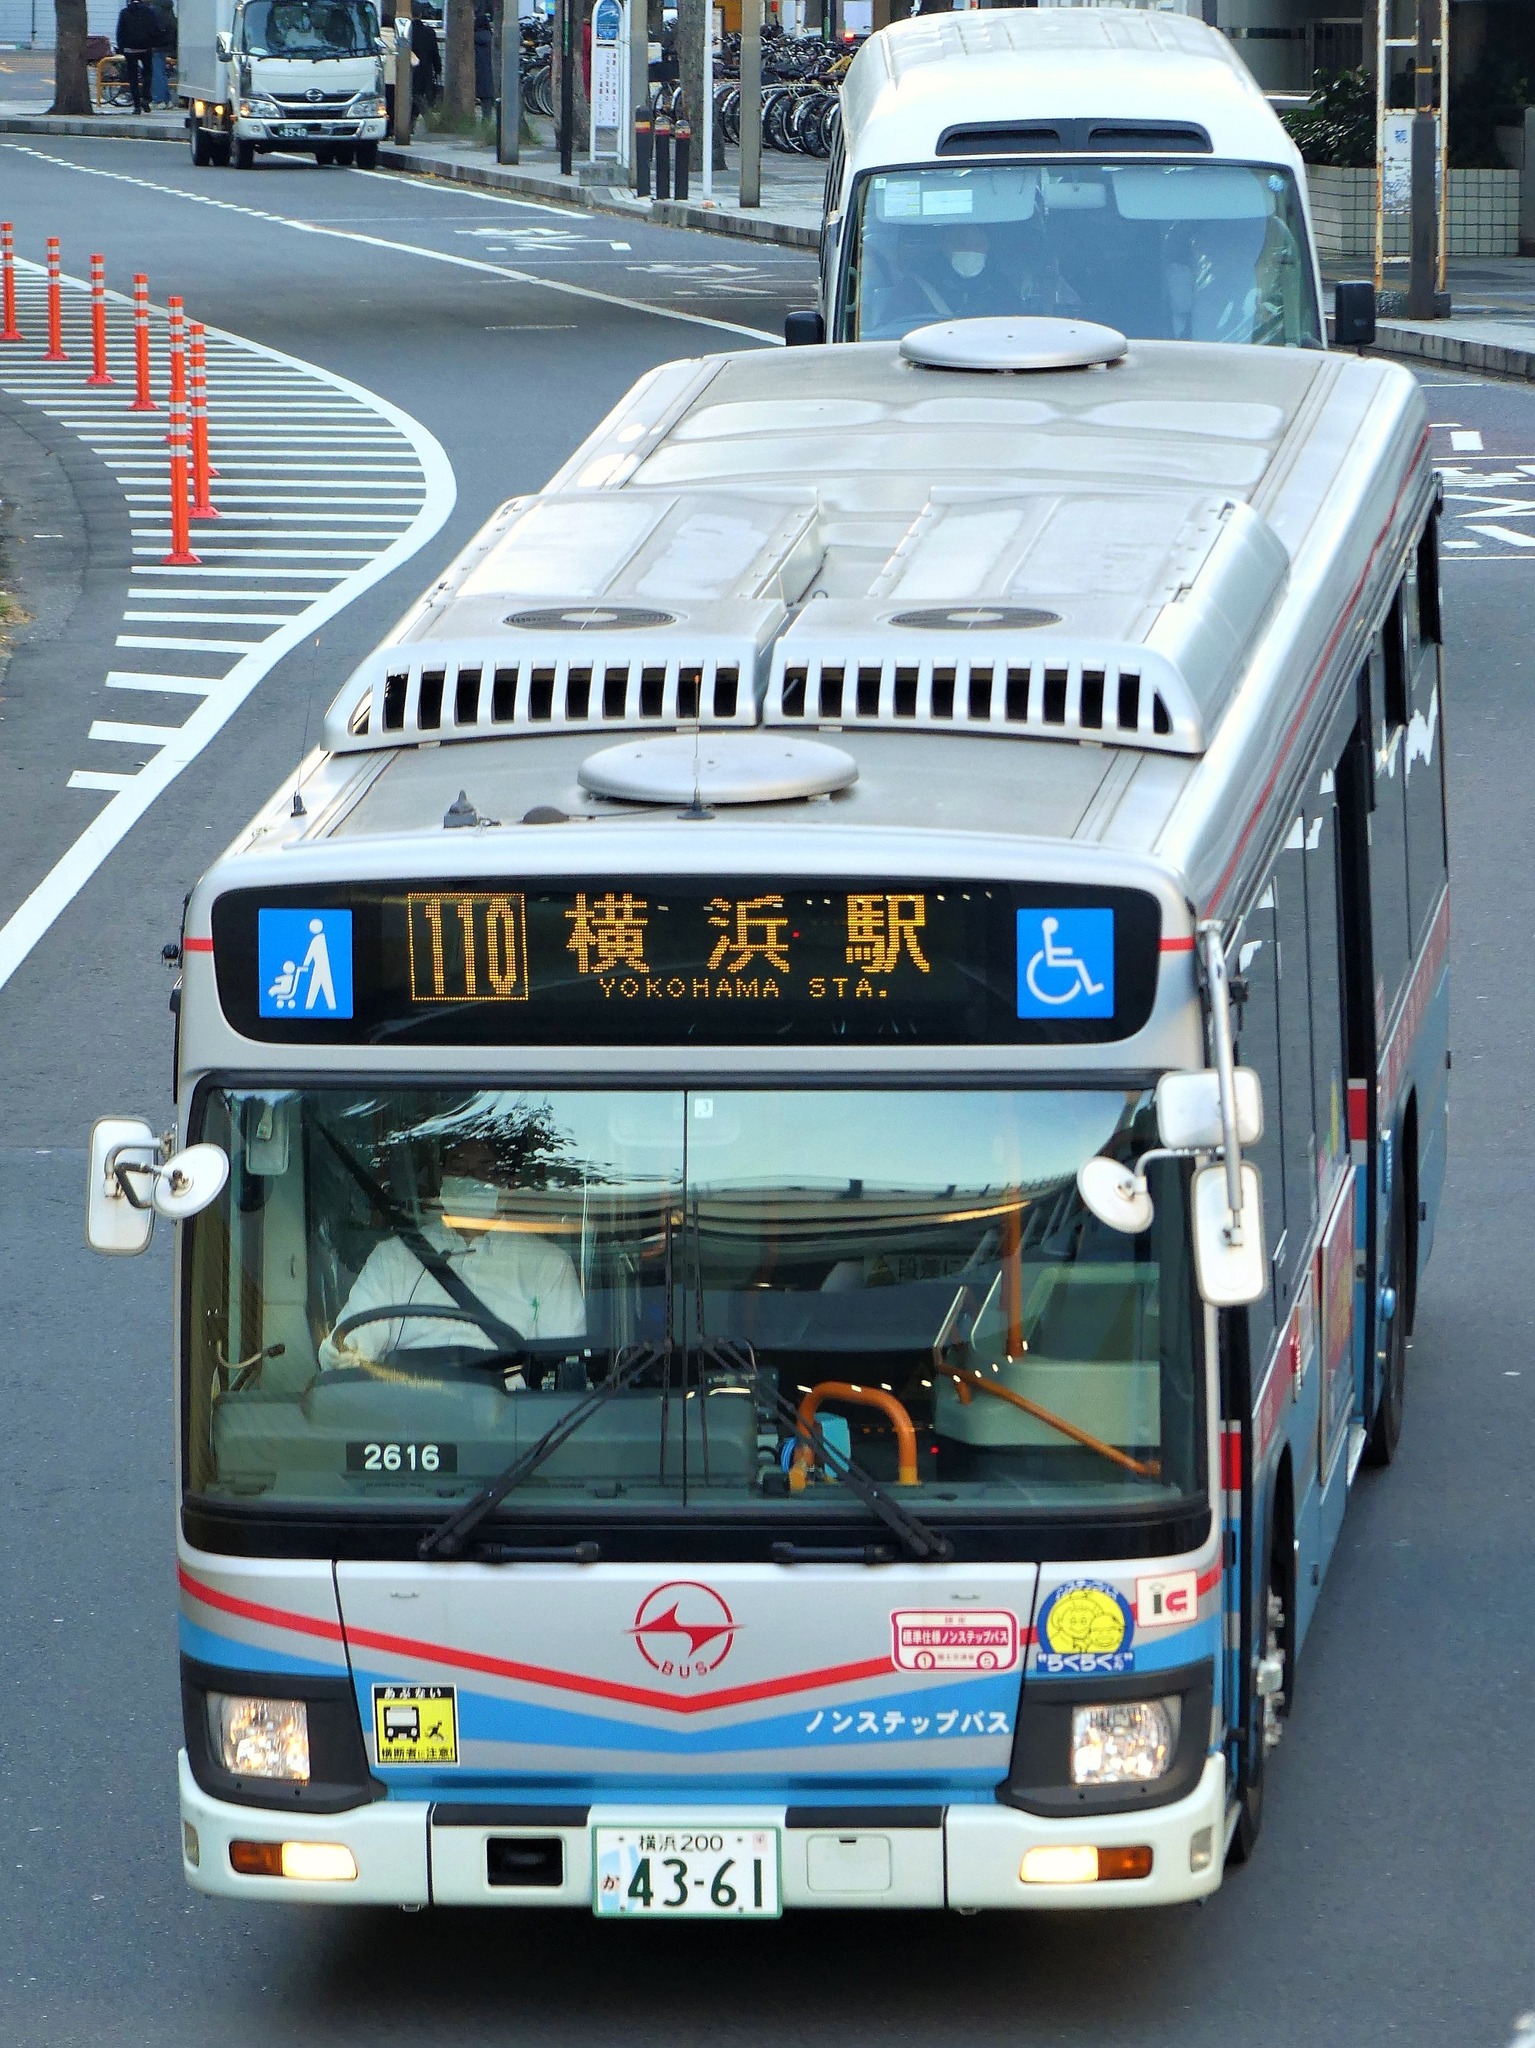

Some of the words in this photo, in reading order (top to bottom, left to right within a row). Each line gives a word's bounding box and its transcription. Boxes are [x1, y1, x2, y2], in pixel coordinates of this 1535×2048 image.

[425, 897, 517, 995] 110
[565, 893, 930, 975] 横浜駅
[598, 979, 780, 999] YOKOHAMA
[809, 977, 889, 998] STA.
[363, 1443, 440, 1471] 2616
[661, 1658, 708, 1680] BUS
[805, 1708, 1011, 1736] ノンステップバス
[602, 1874, 620, 1891] か
[627, 1857, 763, 1908] 43-61
